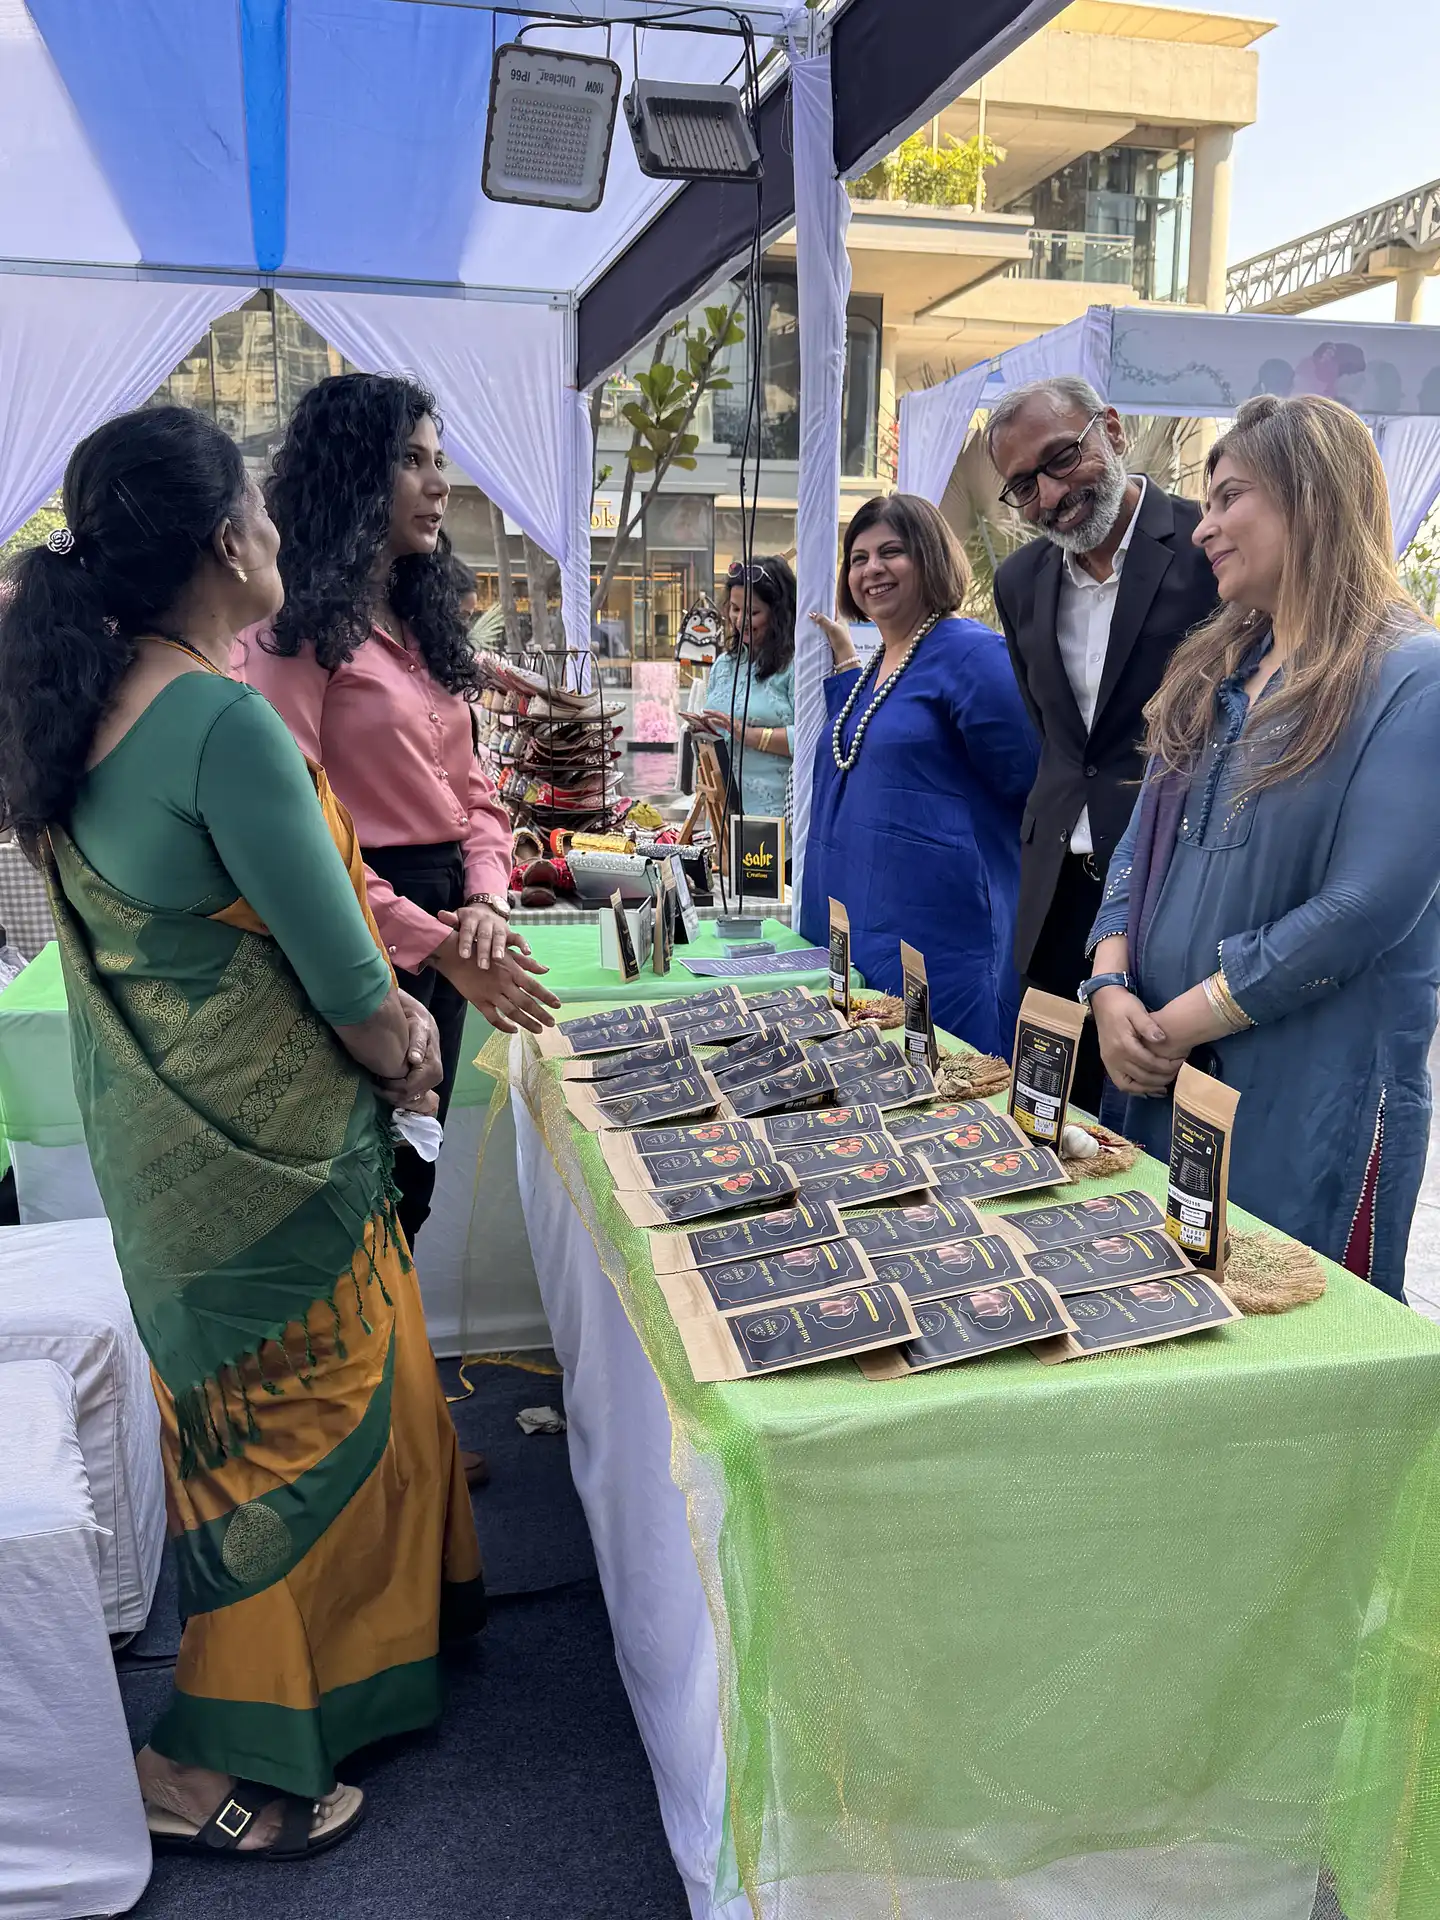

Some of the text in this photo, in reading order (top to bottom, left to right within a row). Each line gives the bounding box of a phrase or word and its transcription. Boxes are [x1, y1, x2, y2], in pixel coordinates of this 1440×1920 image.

[510, 67, 605, 95] 100W Uniclear IP66
